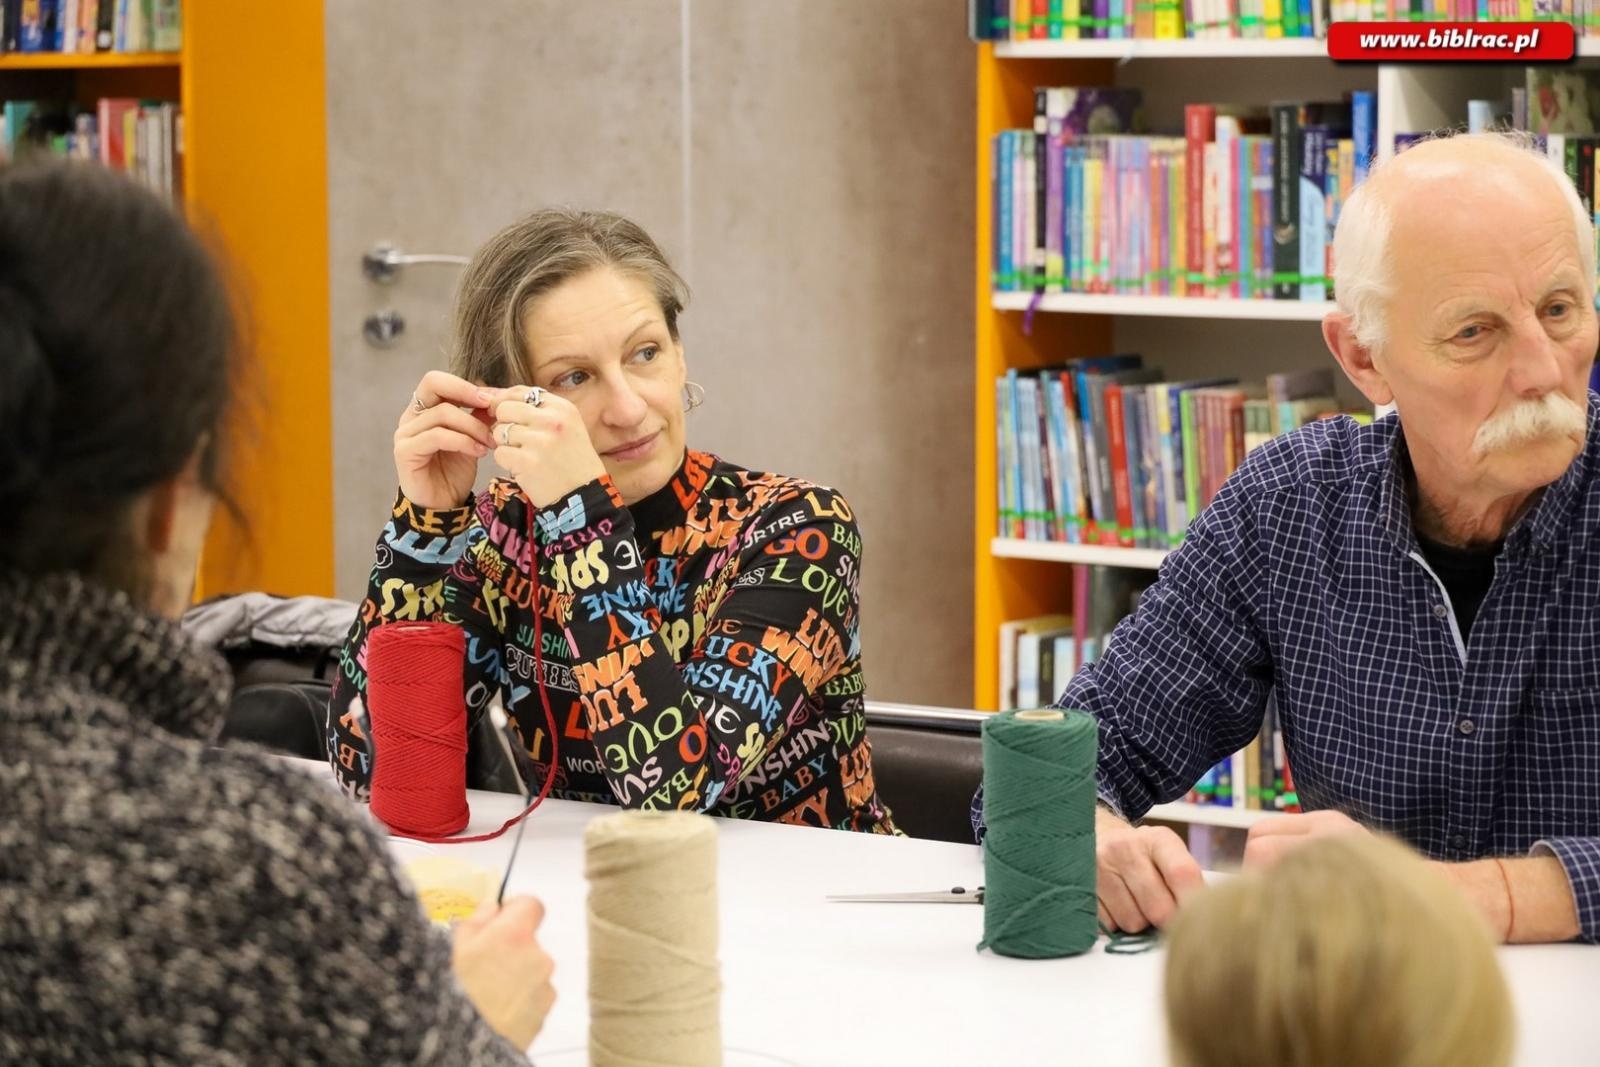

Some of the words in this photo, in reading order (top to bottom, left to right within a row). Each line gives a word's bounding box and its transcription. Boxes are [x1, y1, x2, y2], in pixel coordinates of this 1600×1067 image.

[764, 527, 829, 560] GO
[770, 558, 848, 616] LOVE
[692, 636, 792, 696] LUCKY
[760, 754, 828, 813] BABY
